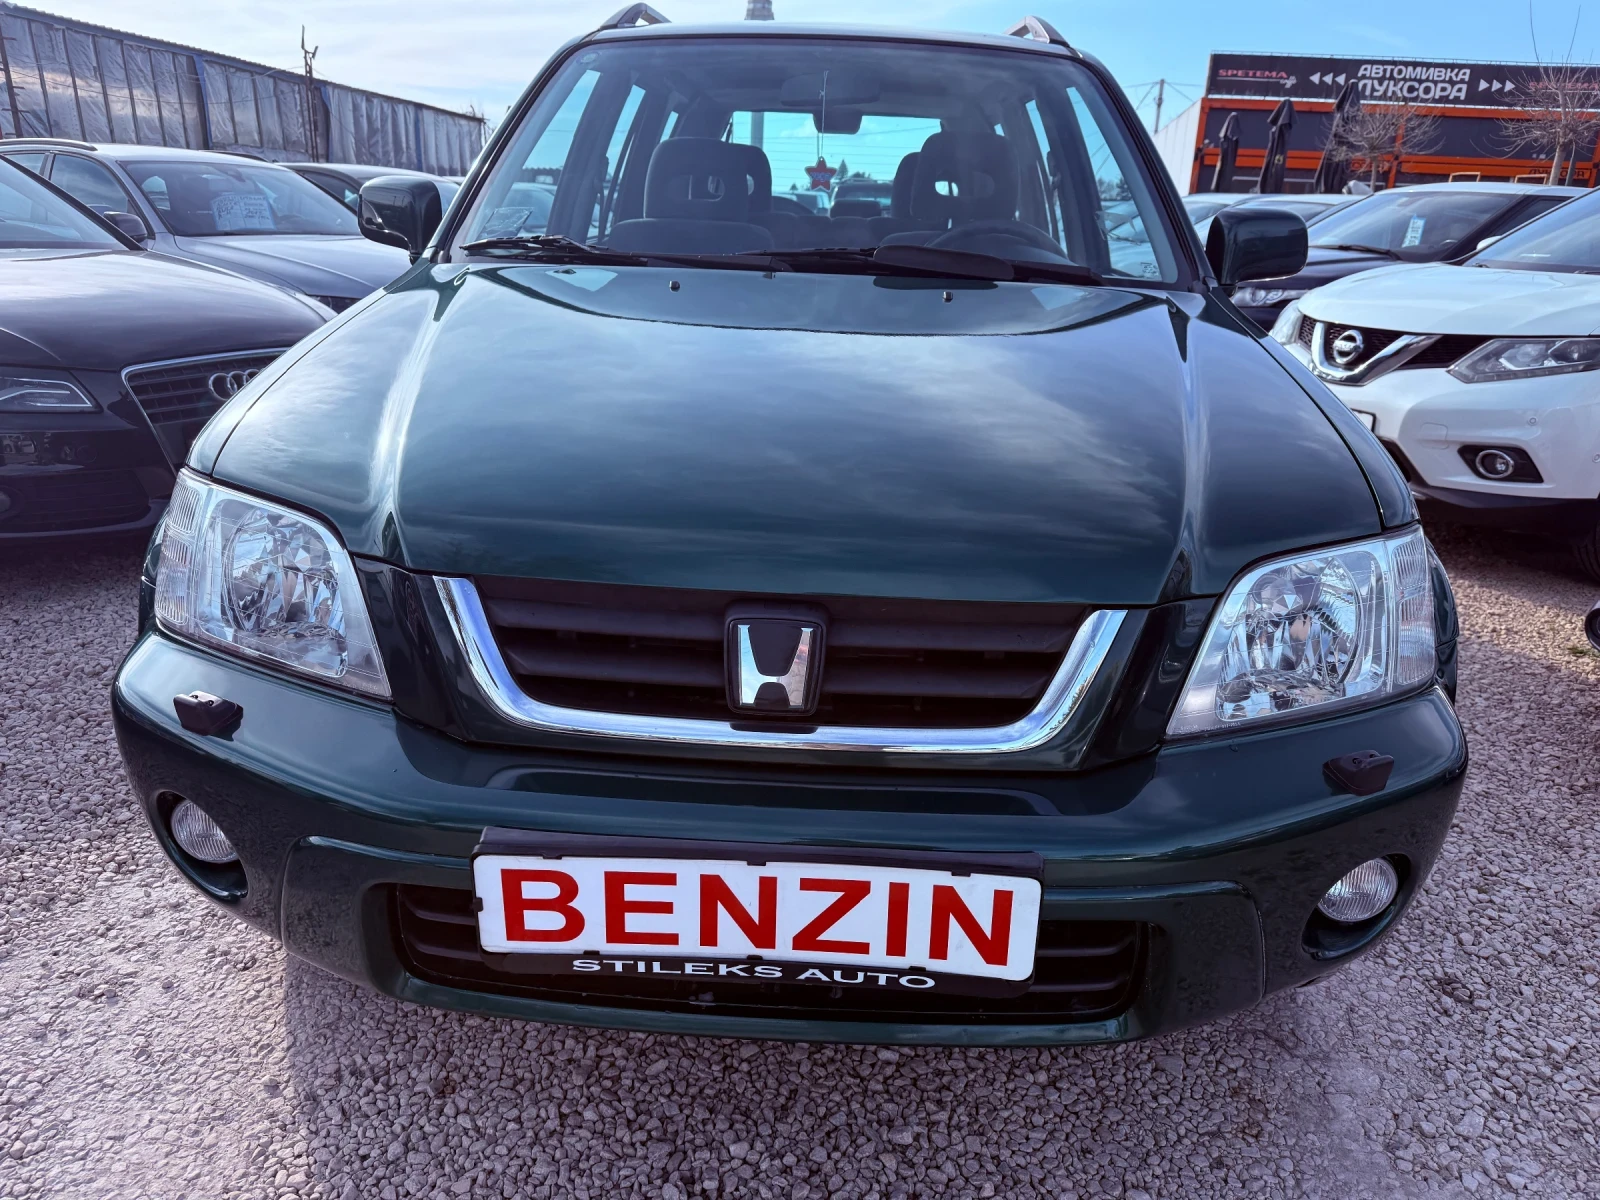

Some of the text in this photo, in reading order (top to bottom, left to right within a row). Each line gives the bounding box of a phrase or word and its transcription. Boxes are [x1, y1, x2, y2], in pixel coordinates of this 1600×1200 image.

[1218, 69, 1289, 79] SPETEMA
[1357, 64, 1471, 82] АВТОМИВКА
[1358, 79, 1468, 100] ЛУКСОРА
[500, 868, 1014, 966] BENZIN
[572, 959, 936, 988] STILEKS AUTO
